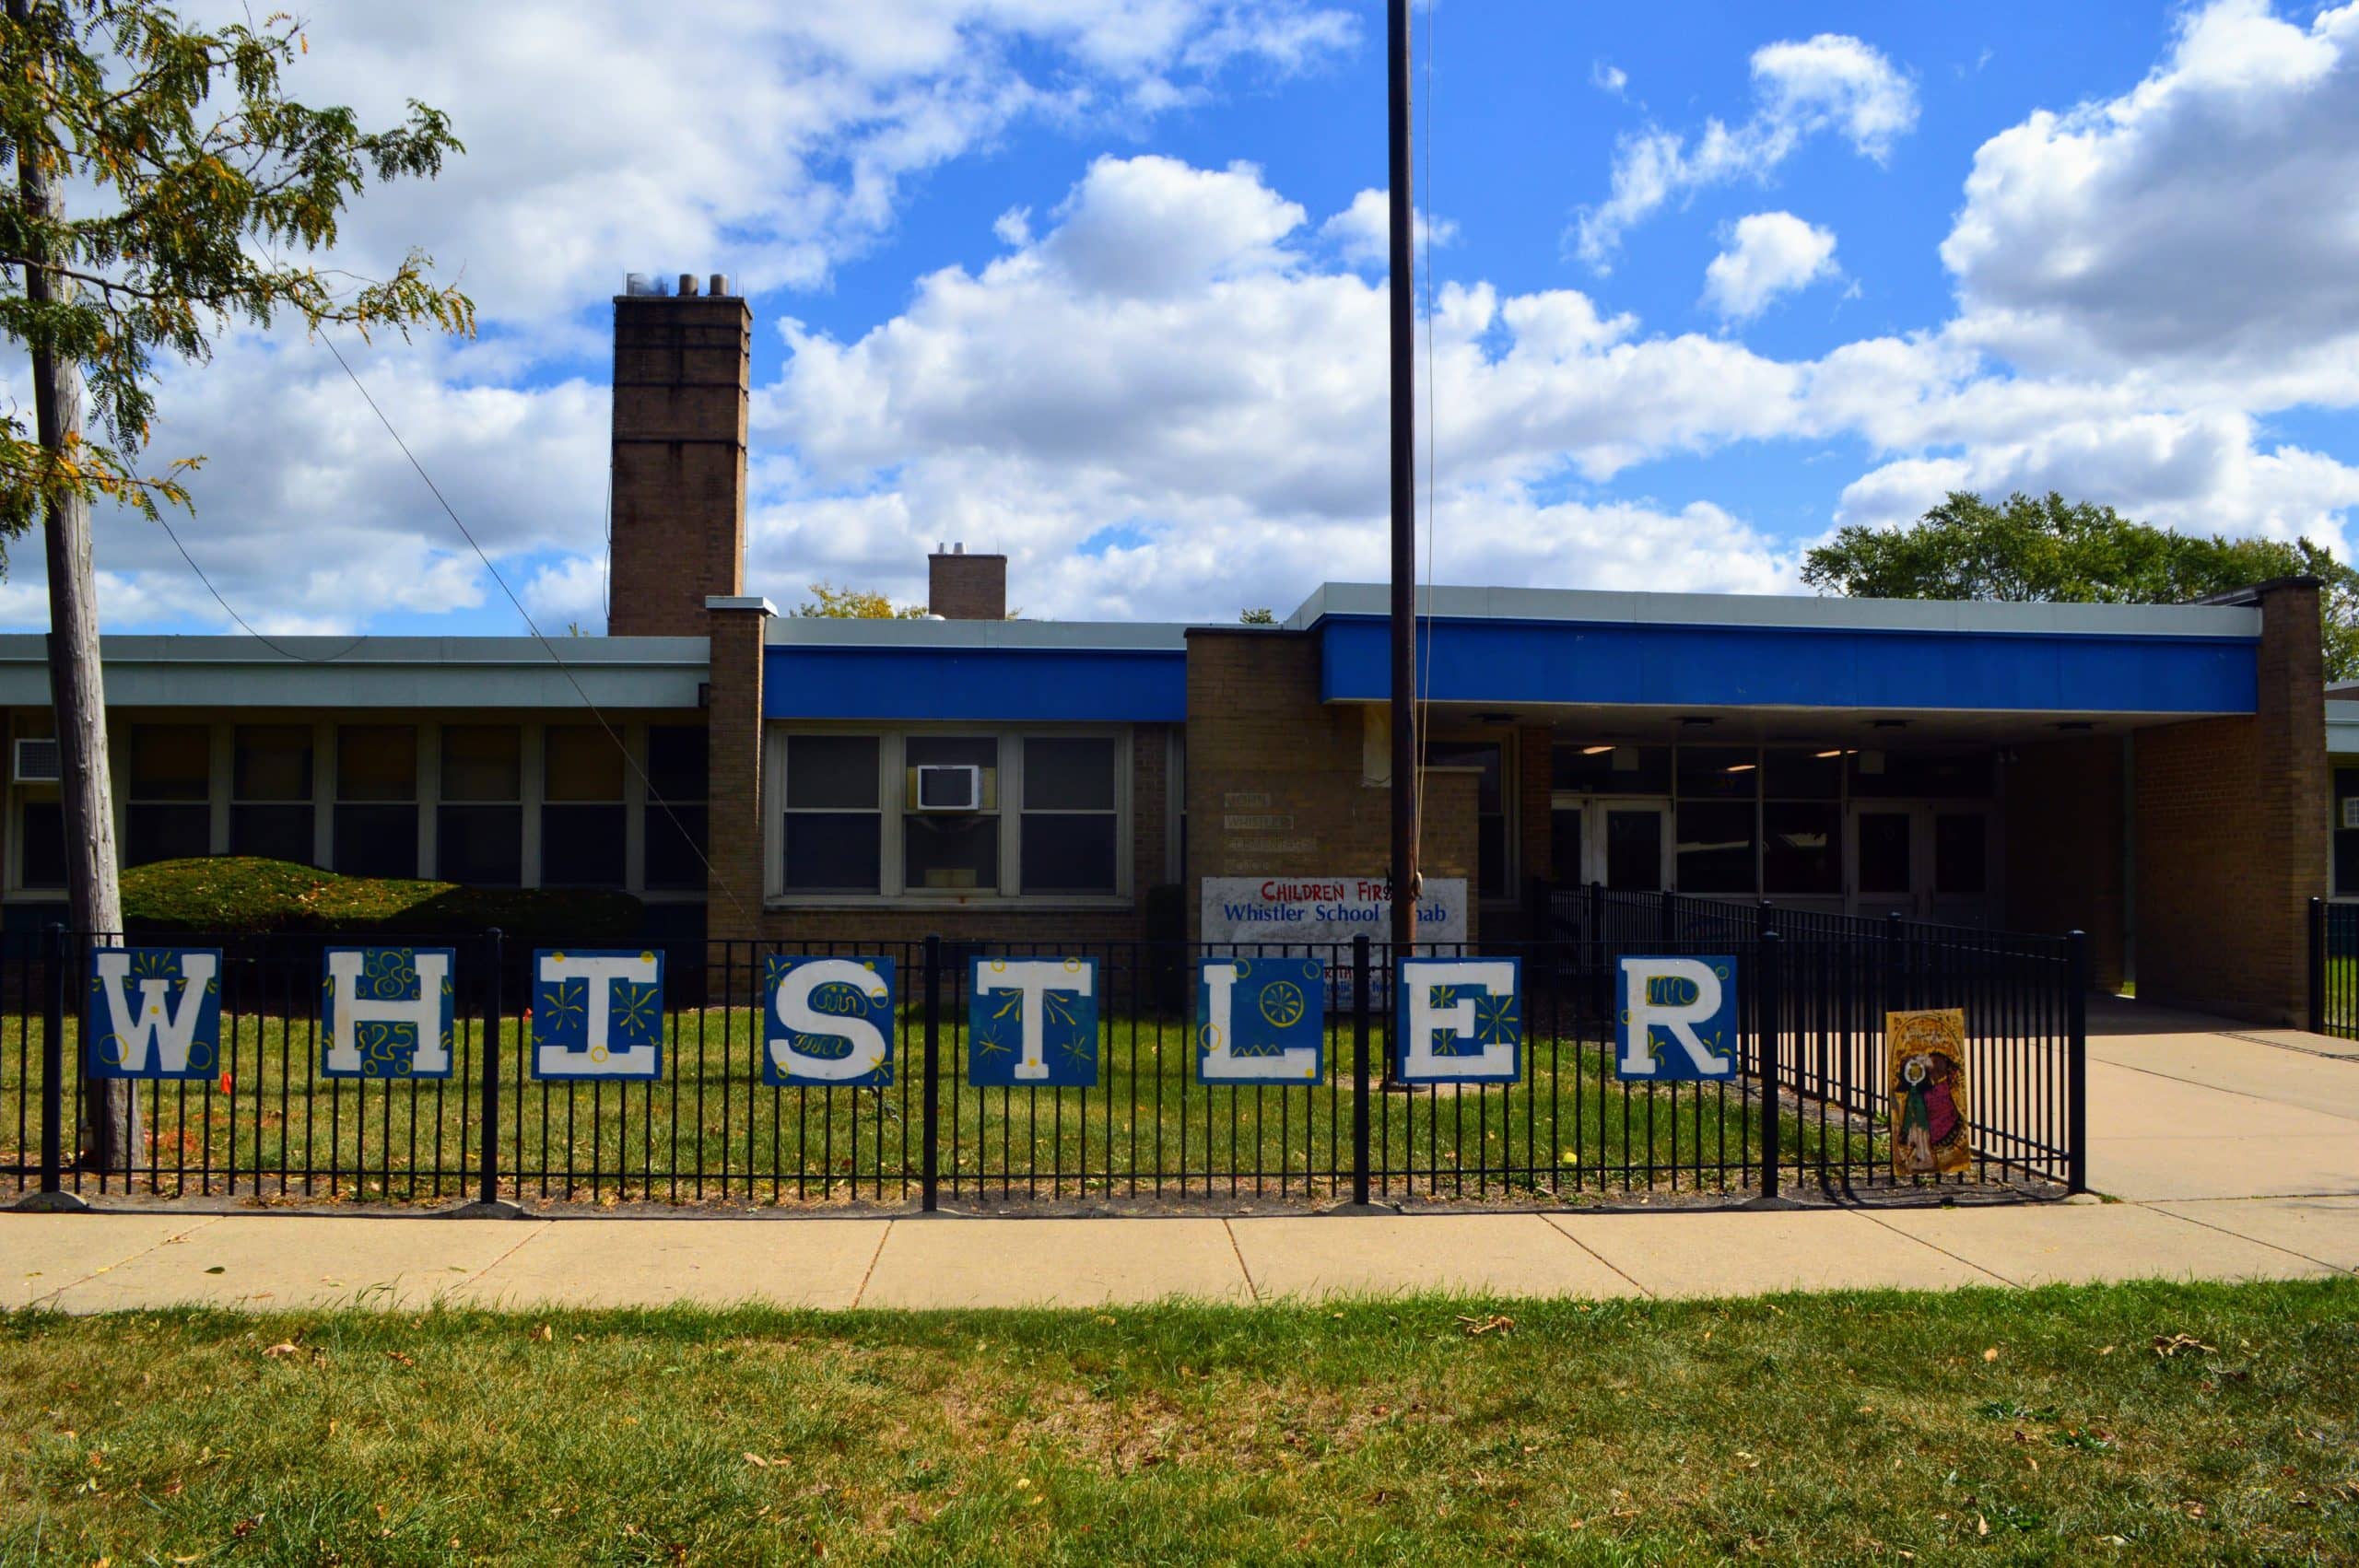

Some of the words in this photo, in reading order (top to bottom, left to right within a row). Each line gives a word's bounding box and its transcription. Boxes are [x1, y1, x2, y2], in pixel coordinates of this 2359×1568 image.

[1262, 881, 1344, 902] CHILDREN
[1357, 881, 1393, 902] FIRS
[1224, 904, 1306, 922] Whistler
[1316, 904, 1379, 922] School
